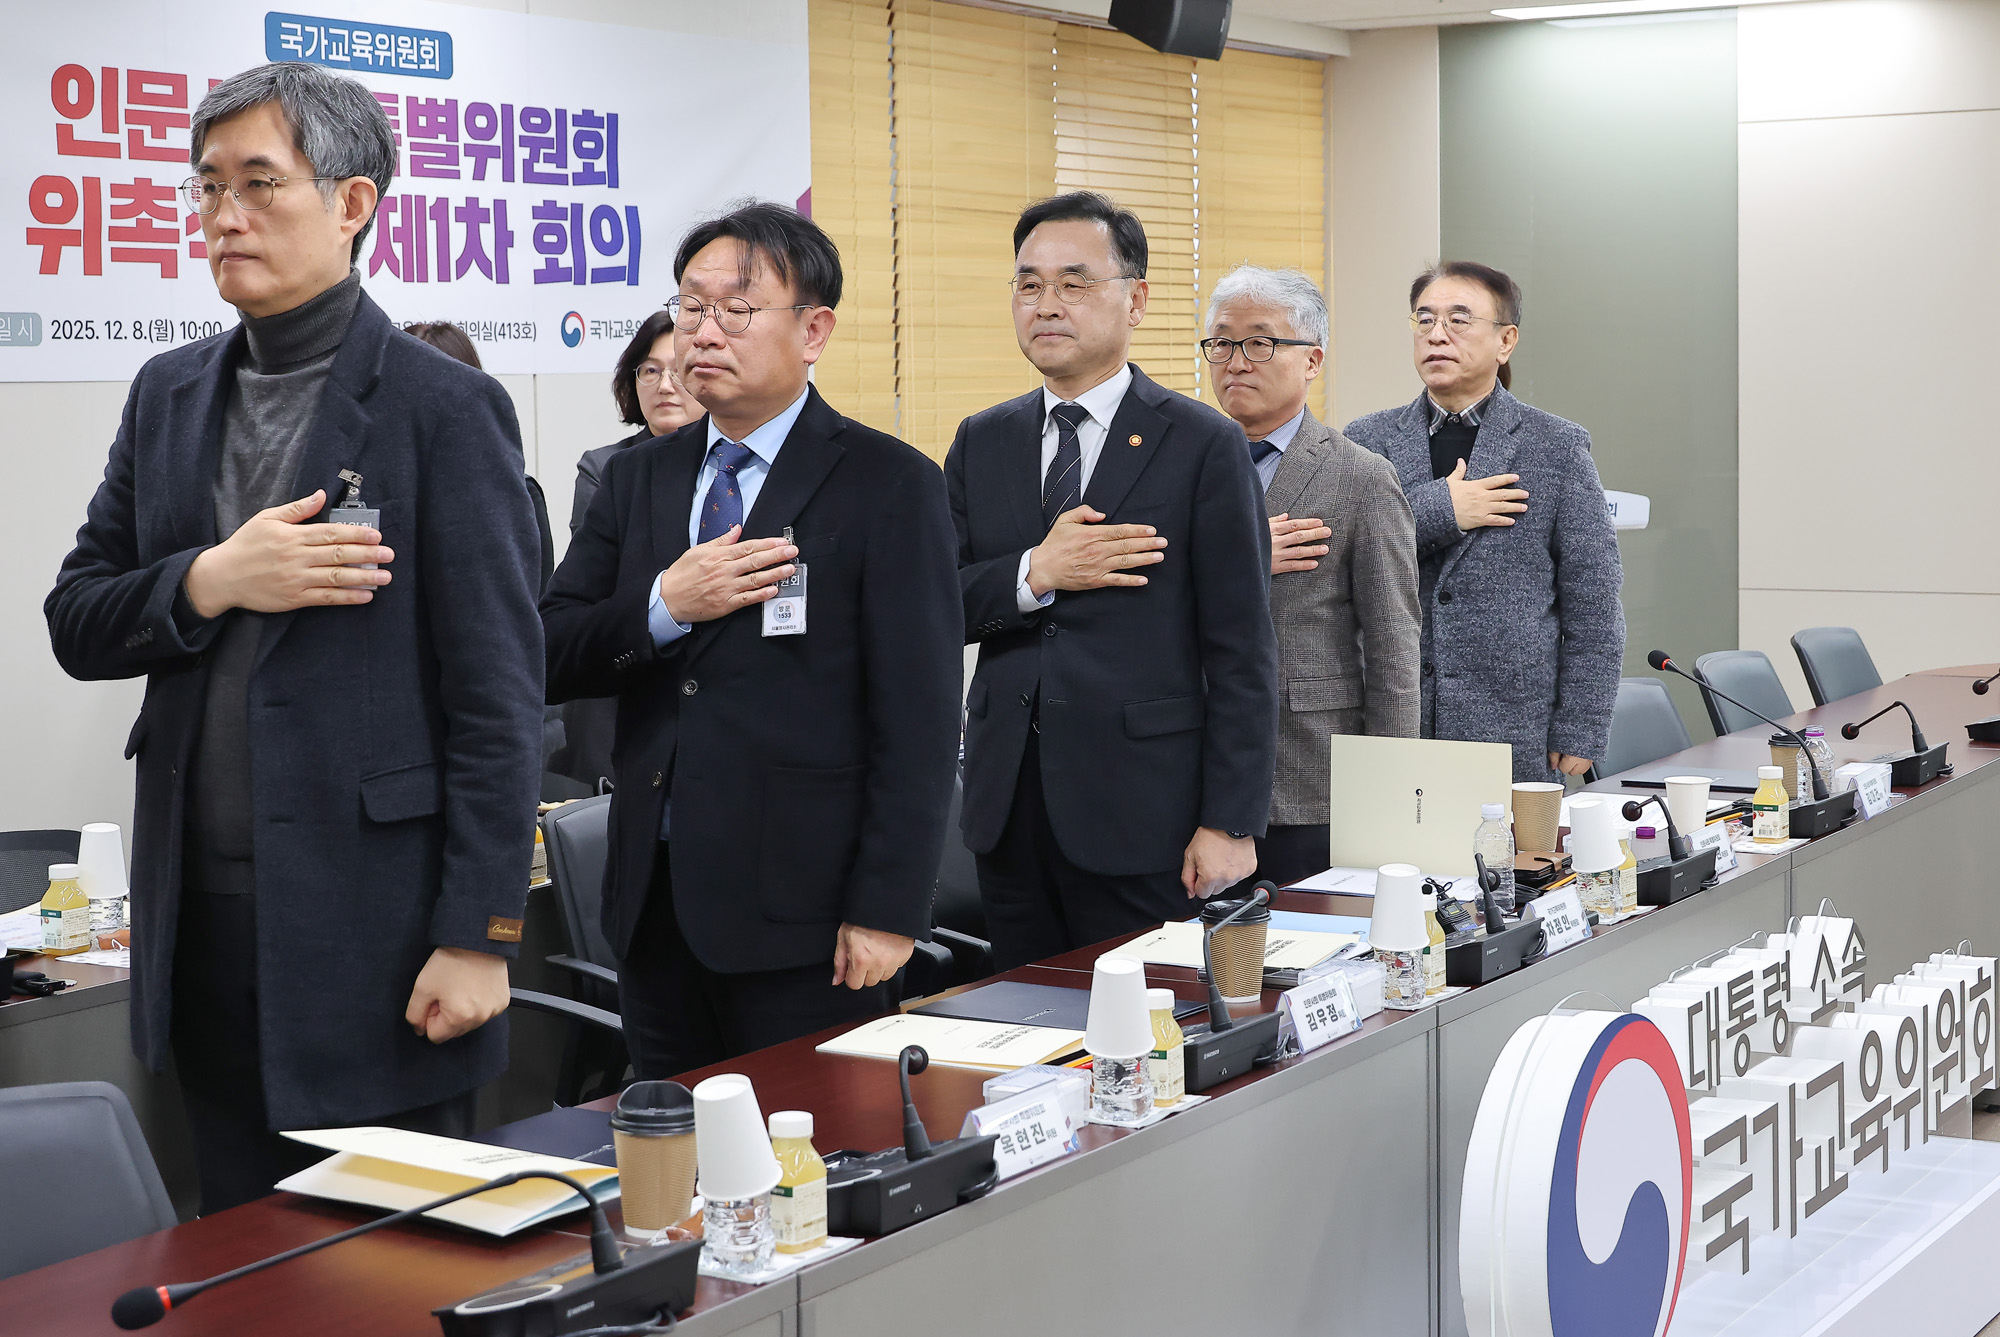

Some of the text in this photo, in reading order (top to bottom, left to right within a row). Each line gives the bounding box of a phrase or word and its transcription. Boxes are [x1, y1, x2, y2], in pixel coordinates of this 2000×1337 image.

[280, 22, 440, 72] 국가교육위원회
[51, 63, 223, 163] 인문
[369, 194, 514, 285] 제1차
[532, 200, 641, 286] 회의
[51, 320, 99, 340] 2025.
[104, 320, 127, 340] 12.
[132, 318, 175, 343] 8.(월)
[590, 319, 646, 340] 국가교육
[1546, 914, 1571, 937] 차정인
[1306, 1003, 1339, 1031] 김우정
[1687, 928, 1867, 1092] 대통령 소속
[1000, 1122, 1058, 1155] 옥현진 위원
[1702, 963, 2000, 1275] 국가교육위원회
